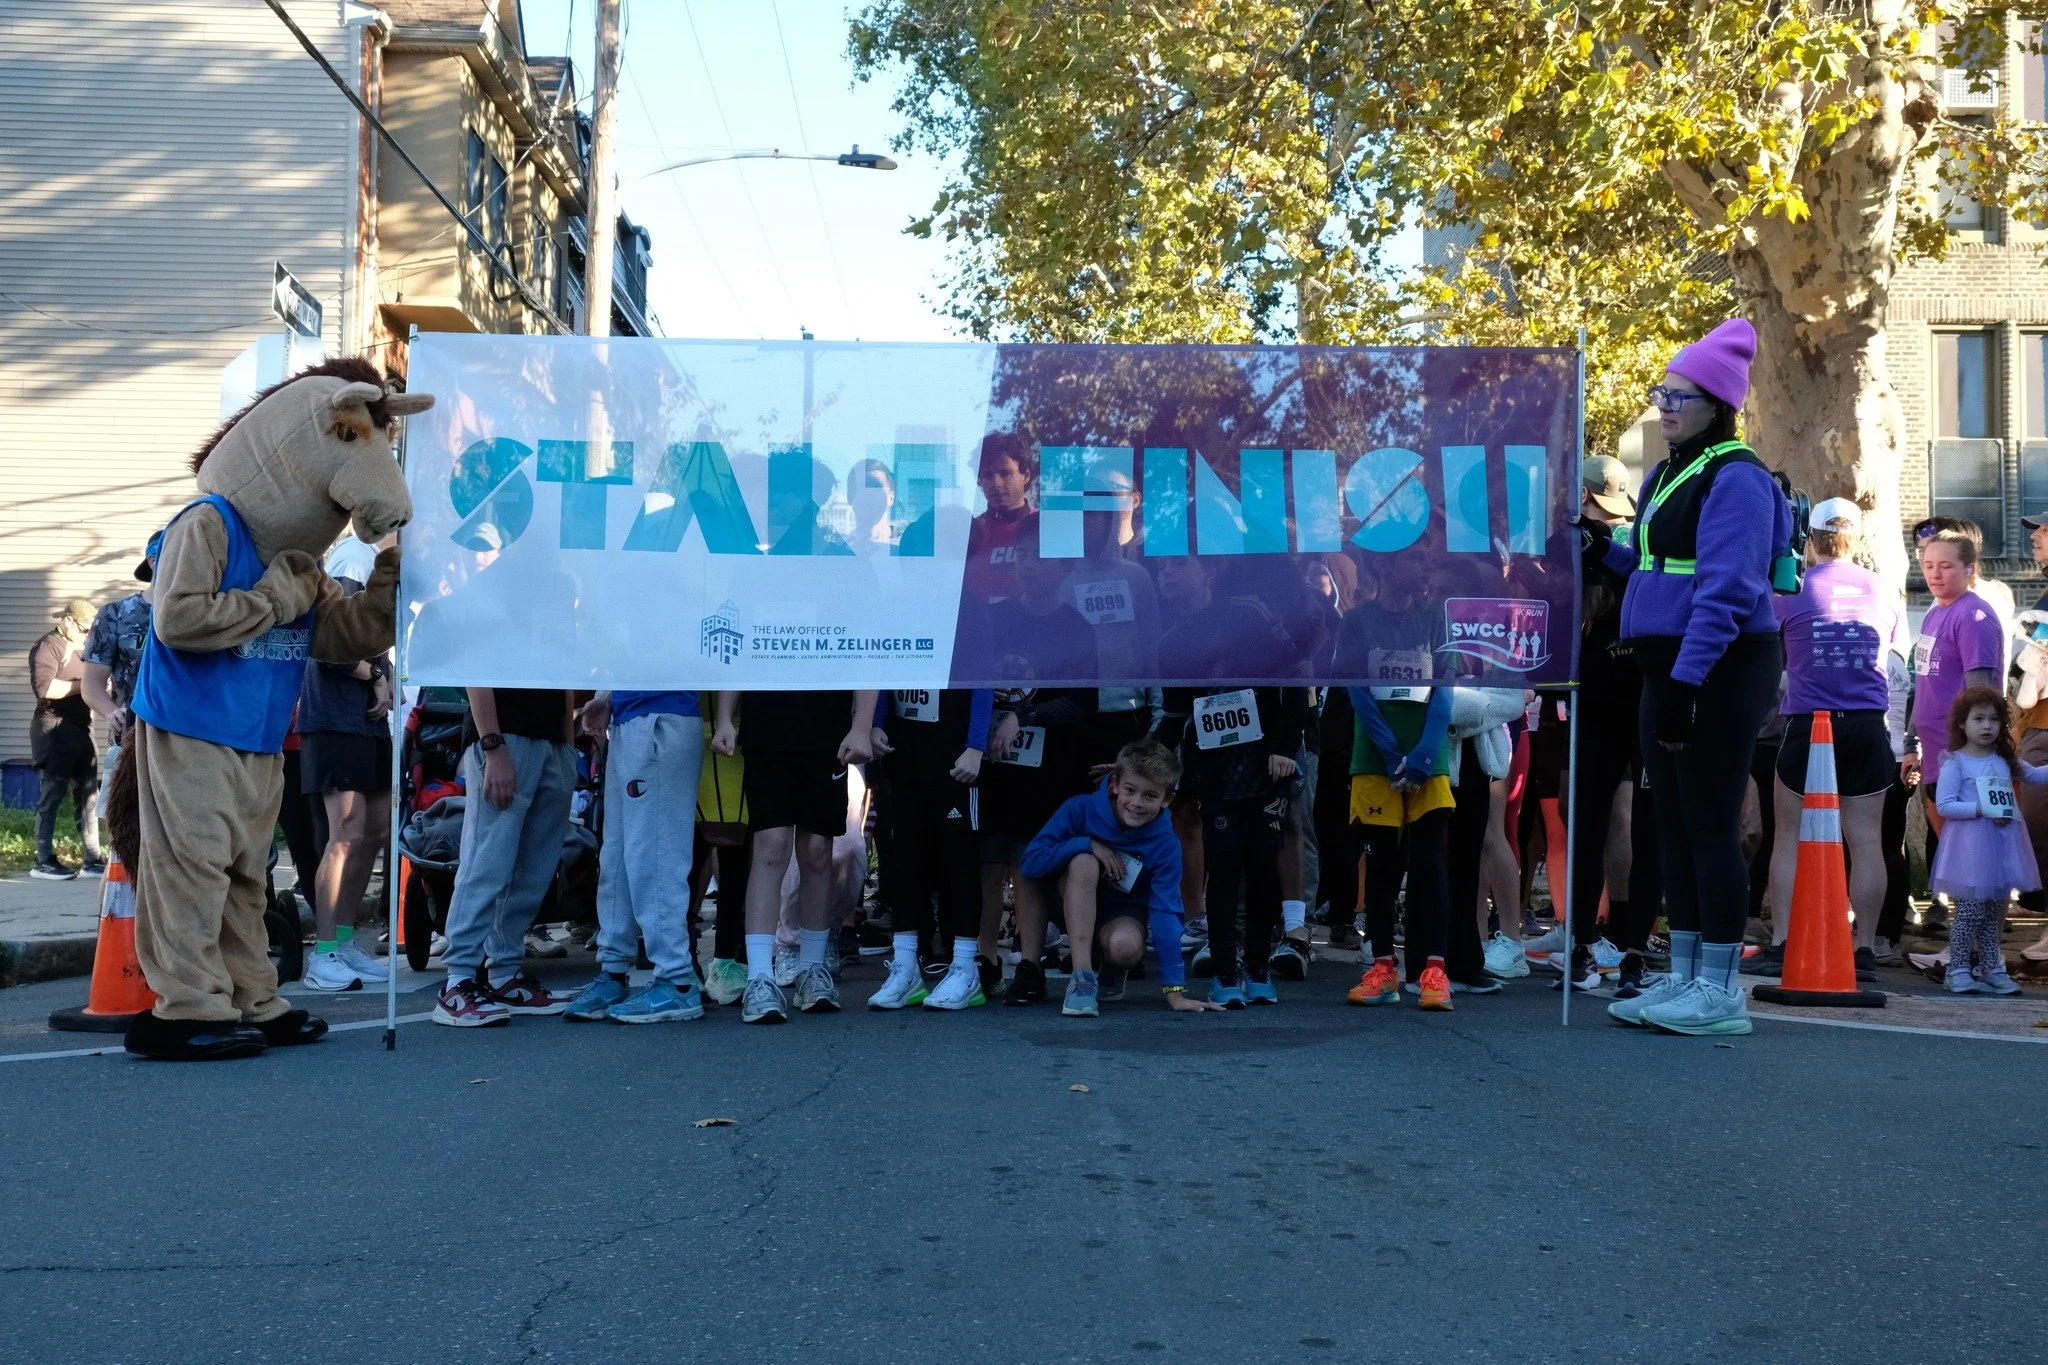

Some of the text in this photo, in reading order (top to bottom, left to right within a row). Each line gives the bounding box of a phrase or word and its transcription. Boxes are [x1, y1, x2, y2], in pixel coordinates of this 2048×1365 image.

[449, 436, 1547, 558] START FINISH
[1085, 594, 1125, 612] 8899
[1526, 609, 1545, 617] RUN
[753, 625, 847, 635] THE LAW OFFICE OF
[1451, 622, 1506, 637] SWCC
[752, 638, 810, 650] STEVEN
[816, 639, 833, 650] M.
[837, 639, 912, 651] ZELINGER
[1379, 666, 1423, 680] 8631
[1202, 707, 1251, 733] 8606
[1012, 730, 1035, 750] 37
